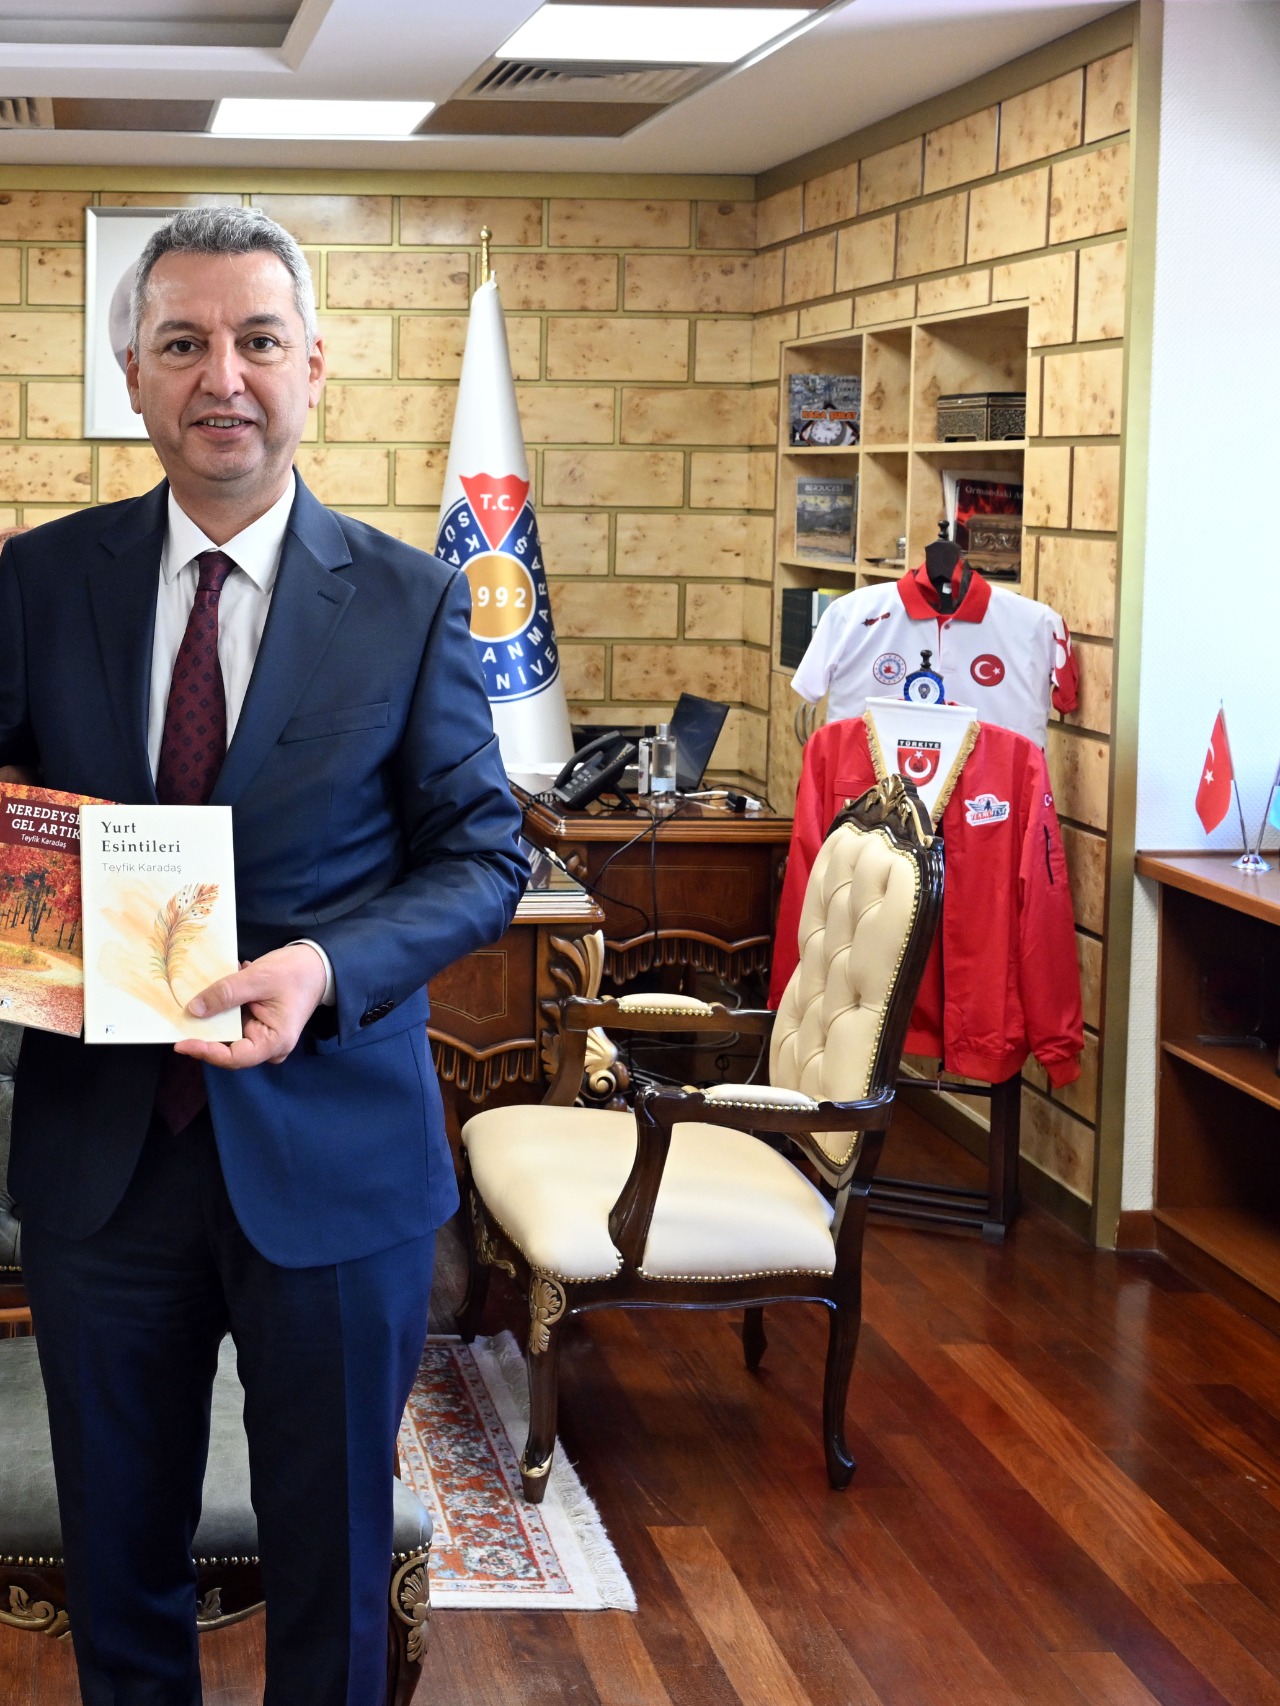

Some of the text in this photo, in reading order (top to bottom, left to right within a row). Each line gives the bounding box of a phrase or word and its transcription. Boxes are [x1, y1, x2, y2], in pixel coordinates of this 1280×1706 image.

[480, 493, 515, 511] T.C.
[471, 585, 527, 608] 992
[899, 740, 940, 749] TÜRKİYE
[11, 818, 81, 840] GEL ARTIK
[101, 821, 136, 834] Yurt
[21, 833, 67, 849] Teyfik Karadaş
[101, 840, 181, 853] Esintileri
[102, 862, 182, 875] Teyfik Karadaş
